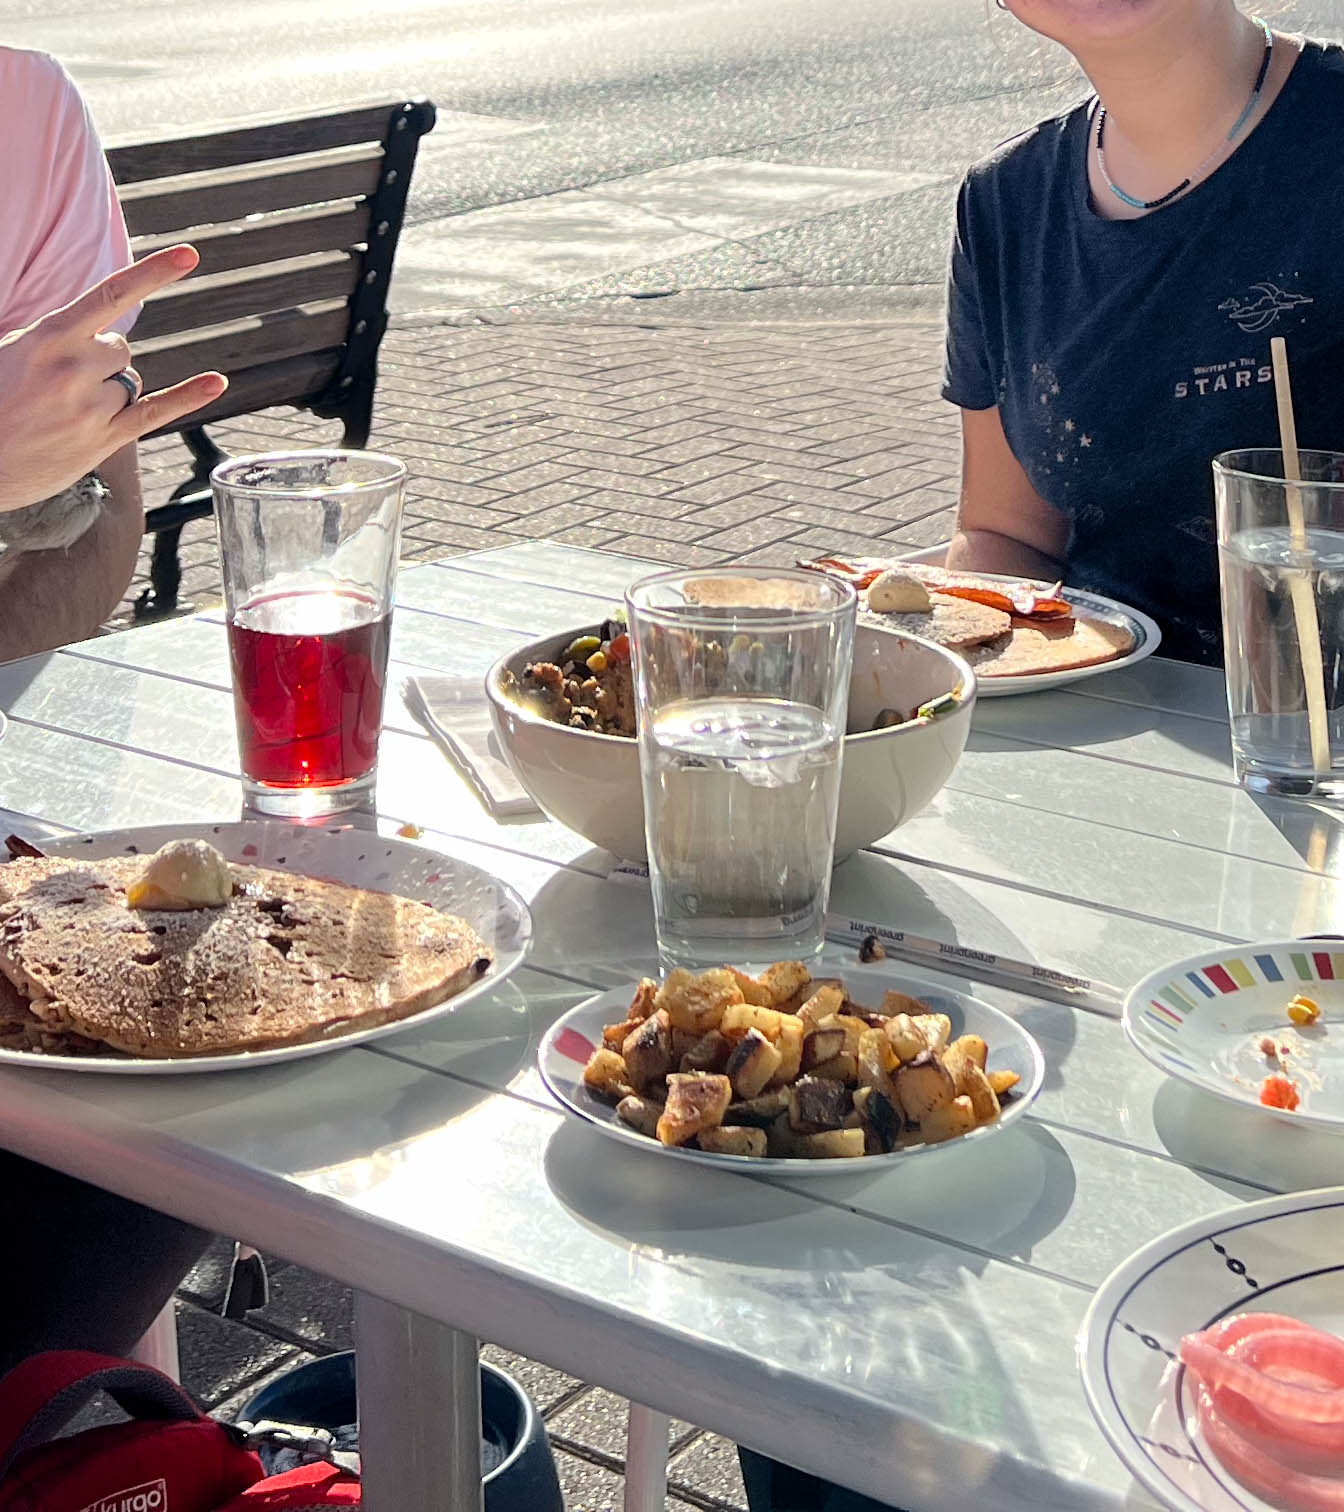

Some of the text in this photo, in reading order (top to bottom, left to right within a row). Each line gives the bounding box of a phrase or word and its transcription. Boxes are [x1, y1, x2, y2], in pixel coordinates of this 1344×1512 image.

[1175, 366, 1273, 398] STARS
[850, 920, 905, 942] greenprint
[939, 943, 996, 963] greenprint
